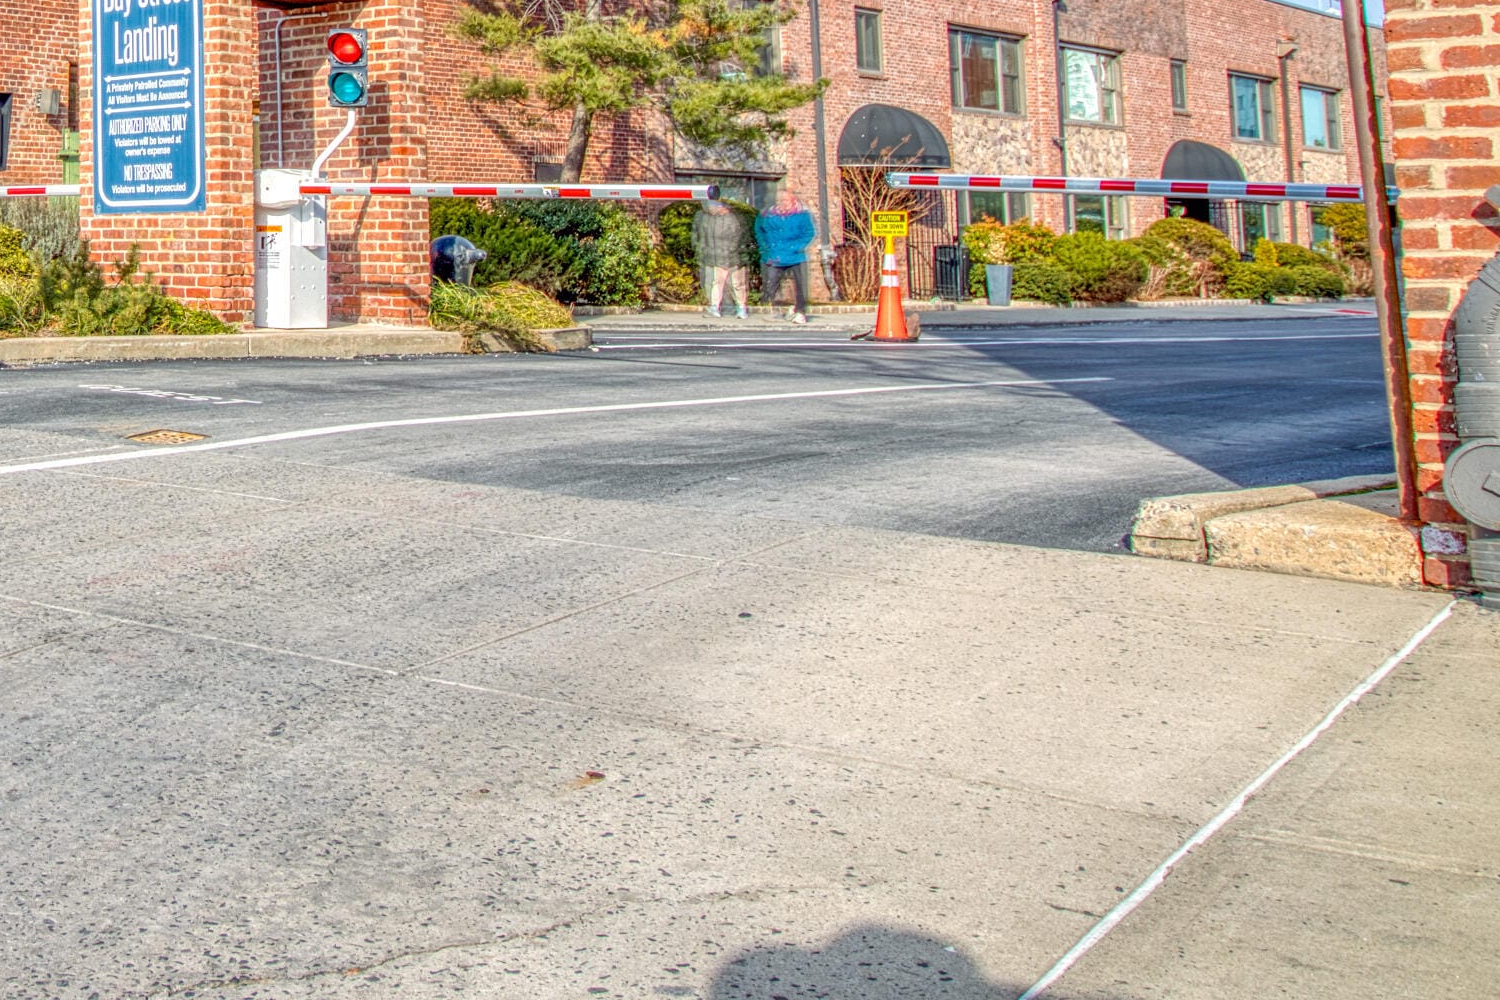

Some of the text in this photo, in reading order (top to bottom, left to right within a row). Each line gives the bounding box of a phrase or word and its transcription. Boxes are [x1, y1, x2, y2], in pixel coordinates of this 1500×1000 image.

[114, 16, 179, 67] Landing
[106, 77, 189, 93] A Privately Patrolled Community
[107, 95, 115, 105] All
[116, 94, 135, 104] Visitors
[108, 113, 187, 136] AUTHORIZED PARKING ONLY
[114, 134, 182, 147] Violators will be towed at
[147, 147, 171, 157] expense
[123, 163, 173, 181] NO TRESPASSING
[111, 182, 187, 195] Violators will be prosecuted
